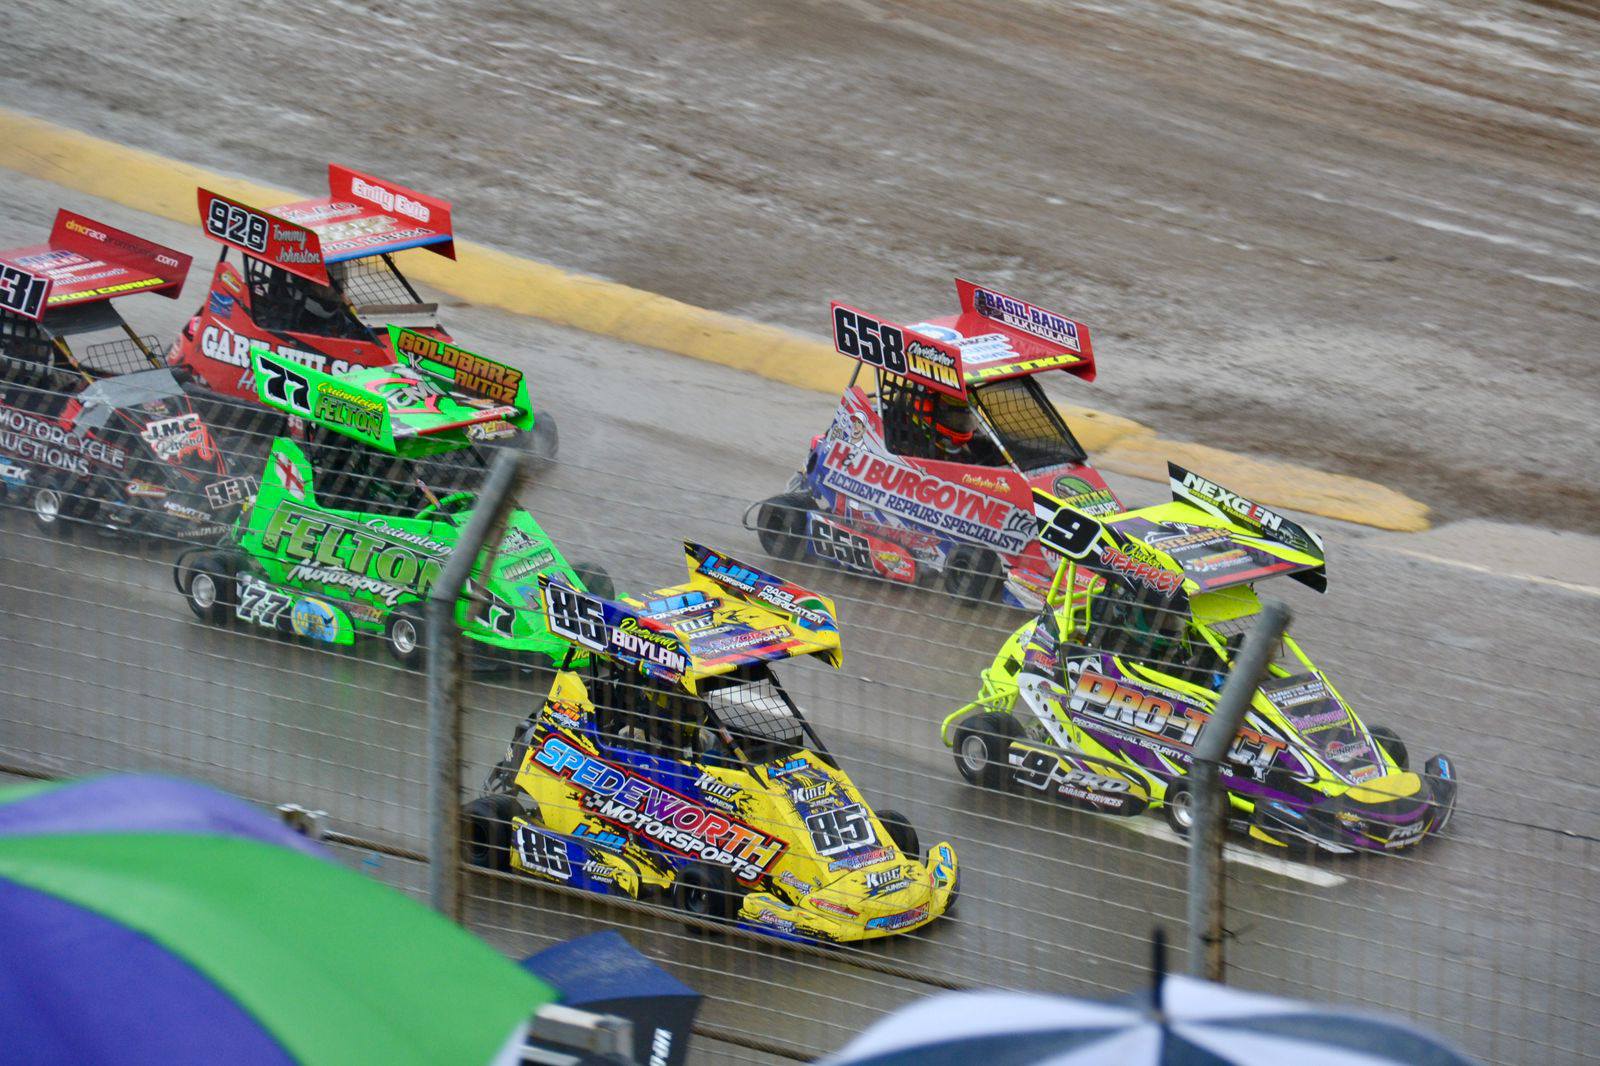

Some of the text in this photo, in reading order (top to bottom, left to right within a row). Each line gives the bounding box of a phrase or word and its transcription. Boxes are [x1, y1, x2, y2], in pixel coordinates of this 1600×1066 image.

[352, 177, 394, 213] Emily
[205, 197, 269, 253] 928
[273, 224, 307, 250] Tommy
[0, 262, 48, 318] 31
[96, 277, 165, 295] CAIRNS
[985, 291, 1076, 338] BASIL BAIRD
[1004, 313, 1078, 347] BULK HAULAGE
[834, 306, 907, 375] 658
[907, 341, 955, 367] Christopher
[255, 354, 312, 415] 77
[316, 381, 385, 413] Quinnleigh
[454, 368, 518, 406] AUTOZ
[315, 394, 383, 440] FELTON
[828, 471, 885, 507] ACCIDENT
[887, 494, 942, 528] REPAIRS
[942, 511, 1025, 553] SPECIALIST
[864, 457, 1010, 531] BURGOYNE
[1182, 471, 1284, 531] NEXGEN
[365, 518, 455, 559] Quinnleig
[809, 516, 875, 570] 658
[1038, 505, 1102, 559] 9
[286, 558, 411, 607] Motorsport
[707, 569, 756, 593] MOTORSPORT
[763, 584, 794, 602] RACE
[1100, 546, 1195, 605] JEFFREY
[236, 582, 292, 629] 77
[547, 582, 608, 651] 85
[757, 591, 825, 625] FABRICATION
[611, 626, 686, 674] BOYLAN
[1067, 670, 1289, 783] PRO-TCT
[1071, 716, 1138, 747] PROFESSIONAL
[1138, 738, 1186, 763] SECURITY
[1012, 749, 1060, 790] 9
[534, 737, 784, 869] SPEDEWORTH
[705, 794, 734, 811] JUNIOR
[1057, 785, 1124, 807] GARAGE SERVICES
[517, 825, 572, 880] 85
[599, 799, 764, 881] MOTORSPORTS
[805, 802, 876, 857] 85
